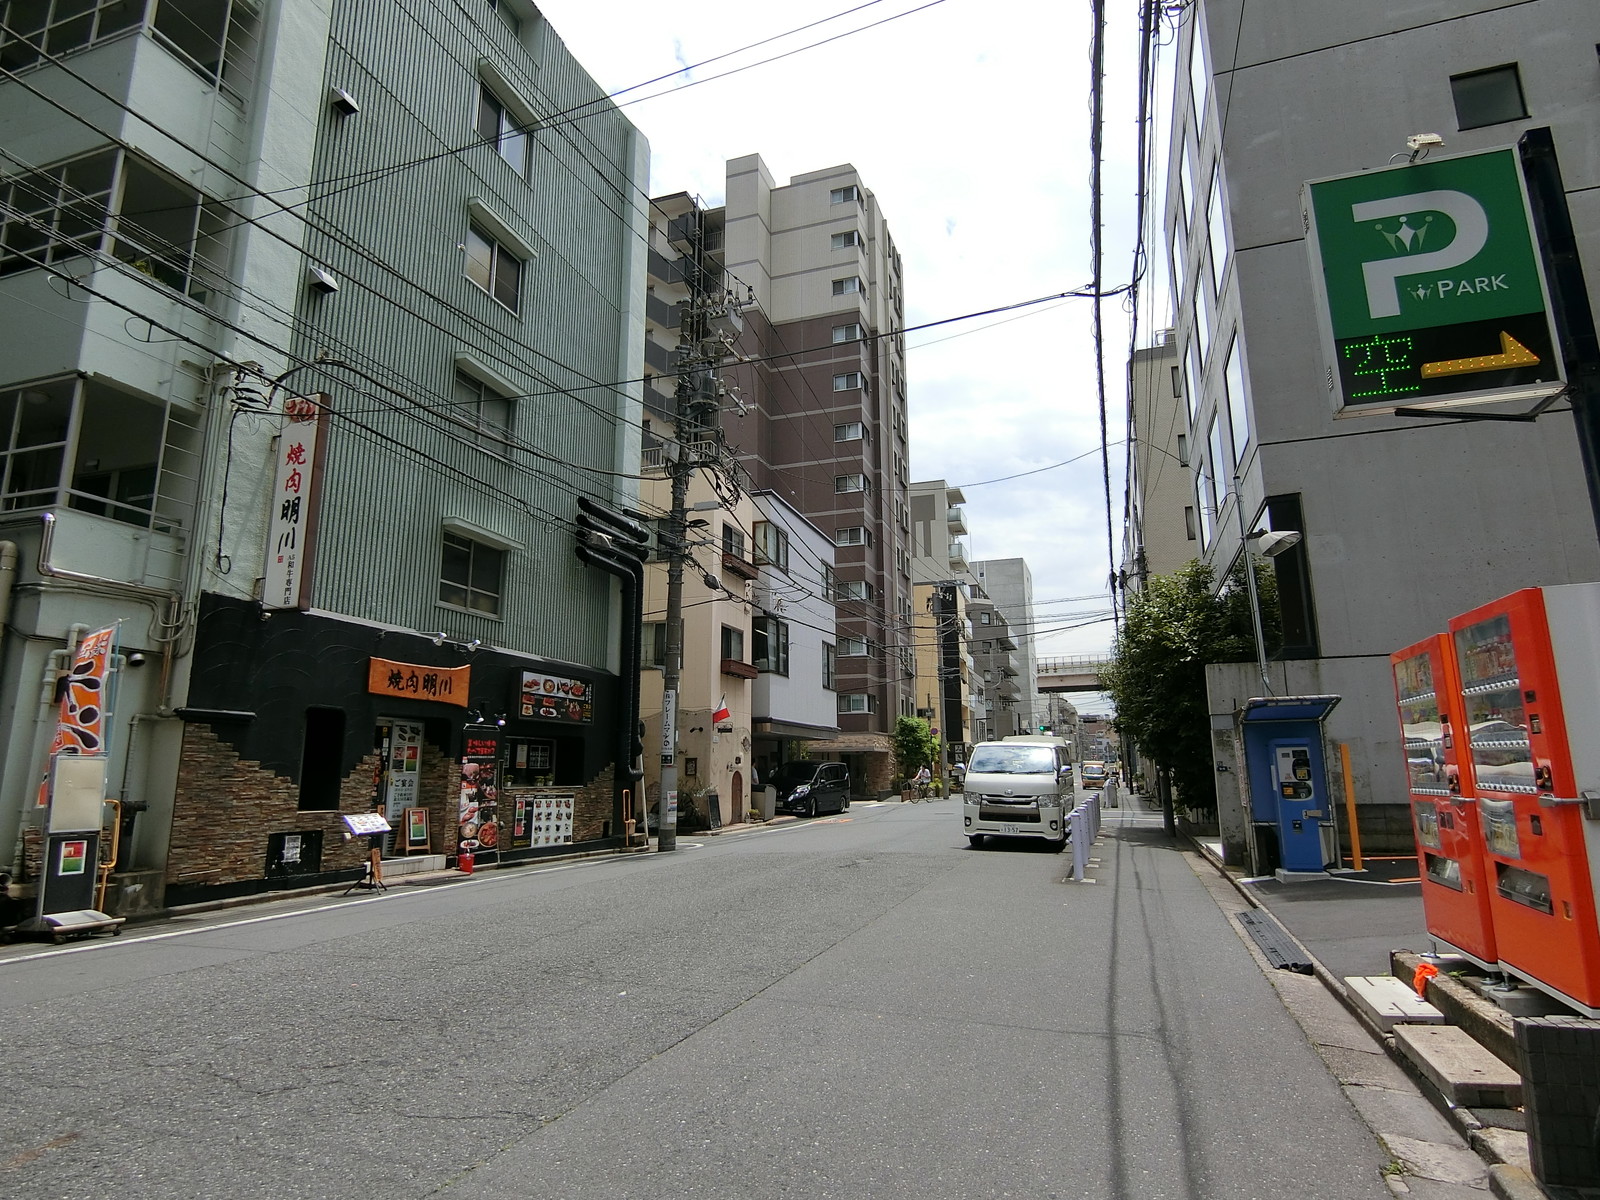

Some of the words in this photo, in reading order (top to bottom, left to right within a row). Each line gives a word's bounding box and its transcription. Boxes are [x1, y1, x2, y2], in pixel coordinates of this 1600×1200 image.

[1351, 189, 1489, 319] P
[1437, 273, 1509, 299] PARK
[1345, 335, 1421, 397] 空
[278, 441, 306, 554] 焼肉明川
[388, 668, 452, 696] 焼肉明川
